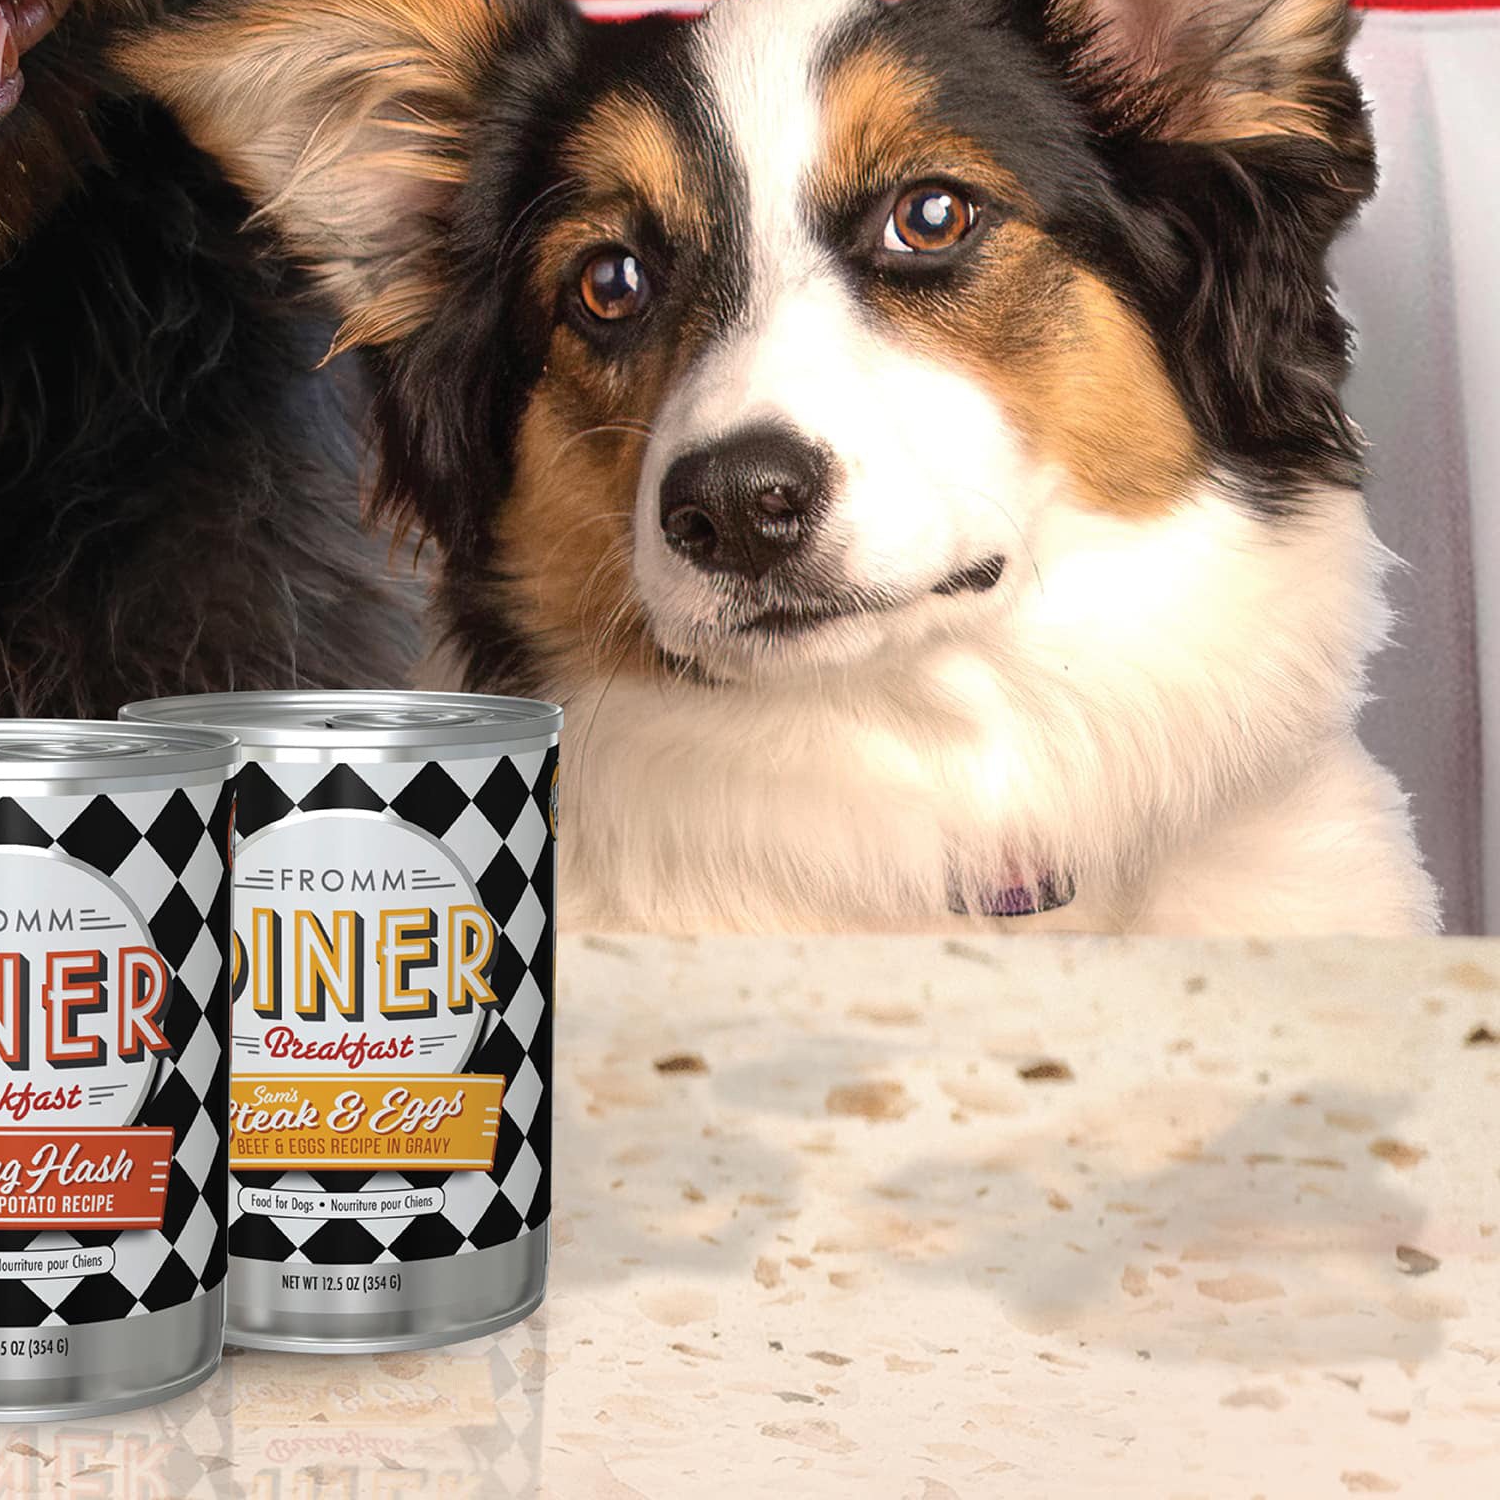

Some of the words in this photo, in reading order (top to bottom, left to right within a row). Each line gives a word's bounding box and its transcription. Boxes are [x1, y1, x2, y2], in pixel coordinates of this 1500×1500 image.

[281, 869, 406, 892] FROMM
[233, 904, 503, 1022] INER
[264, 1026, 414, 1069] Breakfast
[252, 1085, 298, 1107] Sam's
[326, 1091, 366, 1133] &
[369, 1087, 465, 1134] Eggs
[237, 1138, 269, 1155] BEEF
[275, 1138, 284, 1155] &
[289, 1138, 325, 1155] EGGS
[331, 1138, 381, 1155] RECIPE
[387, 1138, 400, 1155] IN
[405, 1137, 451, 1154] GRAVY
[24, 1142, 134, 1195] Hash
[62, 1194, 114, 1212] RECIPE
[251, 1195, 271, 1208] Food
[276, 1195, 288, 1209] for
[291, 1197, 314, 1213] Dogs
[331, 1199, 377, 1212] Nourriture
[381, 1199, 401, 1214] pour
[404, 1196, 433, 1209] Chiens
[47, 1258, 68, 1273] pour
[72, 1254, 102, 1269] Chiens
[282, 1275, 300, 1289] NET
[302, 1276, 318, 1290] WT
[323, 1276, 342, 1290] 12.5
[346, 1276, 359, 1290] OZ
[363, 1276, 386, 1293] (354
[390, 1273, 401, 1292] G)
[11, 1341, 25, 1355] OZ
[29, 1339, 53, 1358] (354
[57, 1338, 69, 1356] G)
